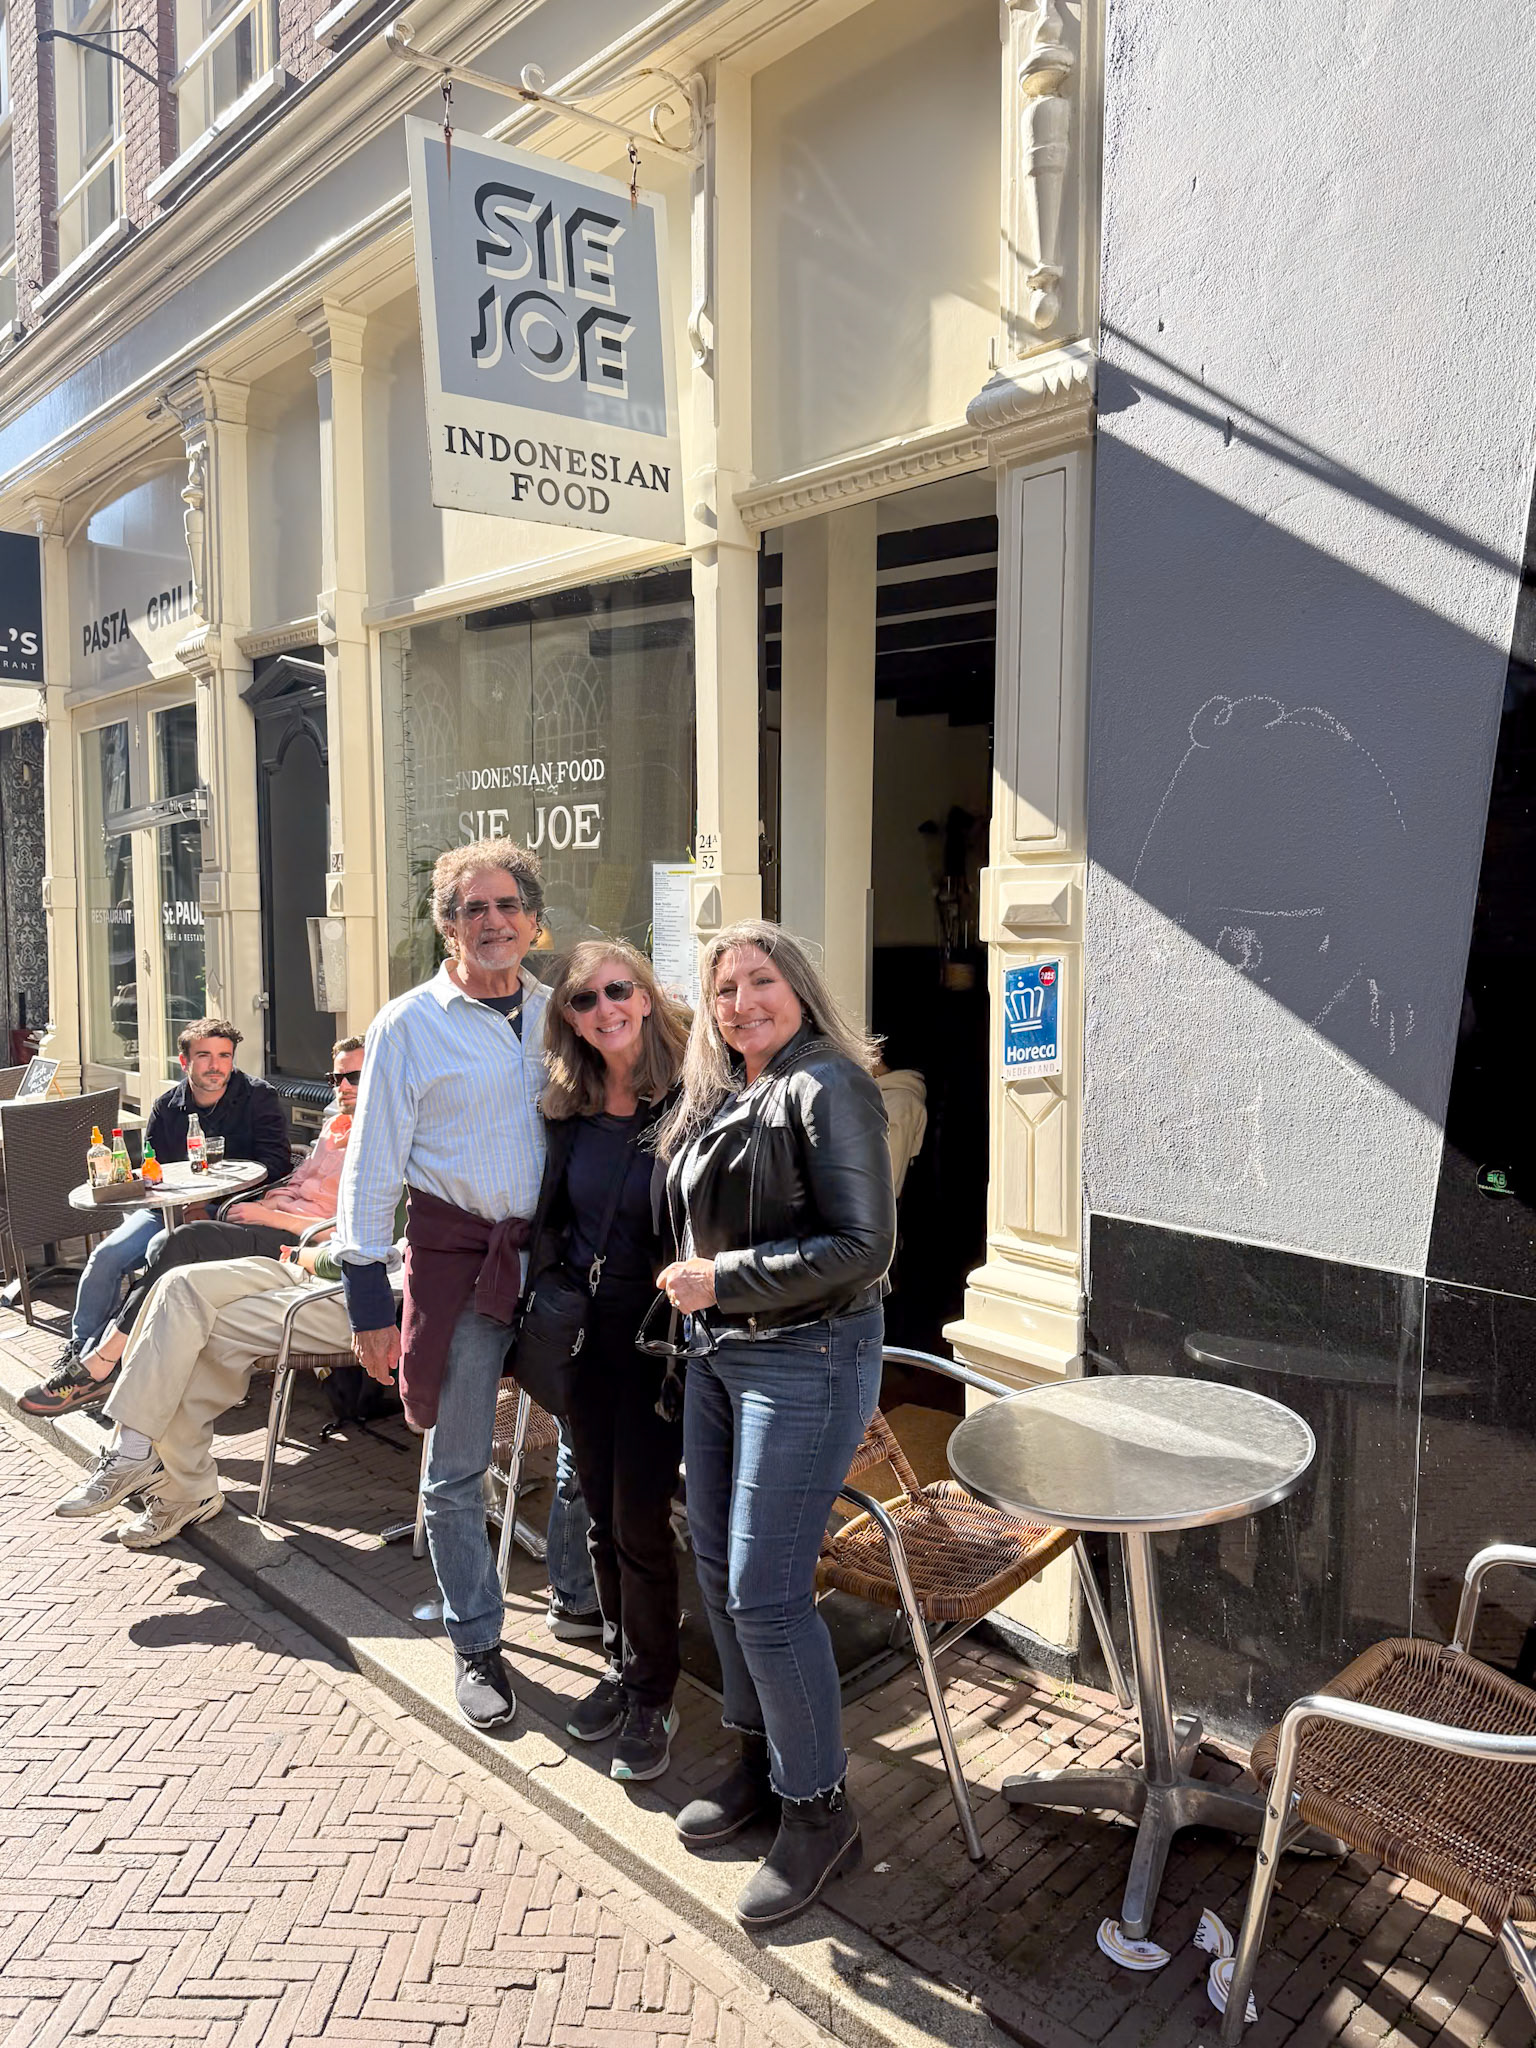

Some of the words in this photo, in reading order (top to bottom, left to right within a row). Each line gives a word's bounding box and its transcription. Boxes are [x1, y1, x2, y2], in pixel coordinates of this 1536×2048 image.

[474, 181, 626, 306] SIE
[471, 284, 637, 399] JOE
[444, 425, 671, 493] INDONESIAN
[511, 472, 610, 515] FOOD
[83, 608, 130, 656] PASTA
[456, 761, 553, 790] INDONESIAN
[556, 757, 605, 784] FOOD
[458, 808, 511, 848] SIE
[526, 803, 601, 850] JOE
[702, 855, 715, 870] 52
[92, 908, 132, 925] RESTAURANT
[1006, 1062, 1056, 1078] NEDERLAND
[1007, 1043, 1056, 1063] Horeca
